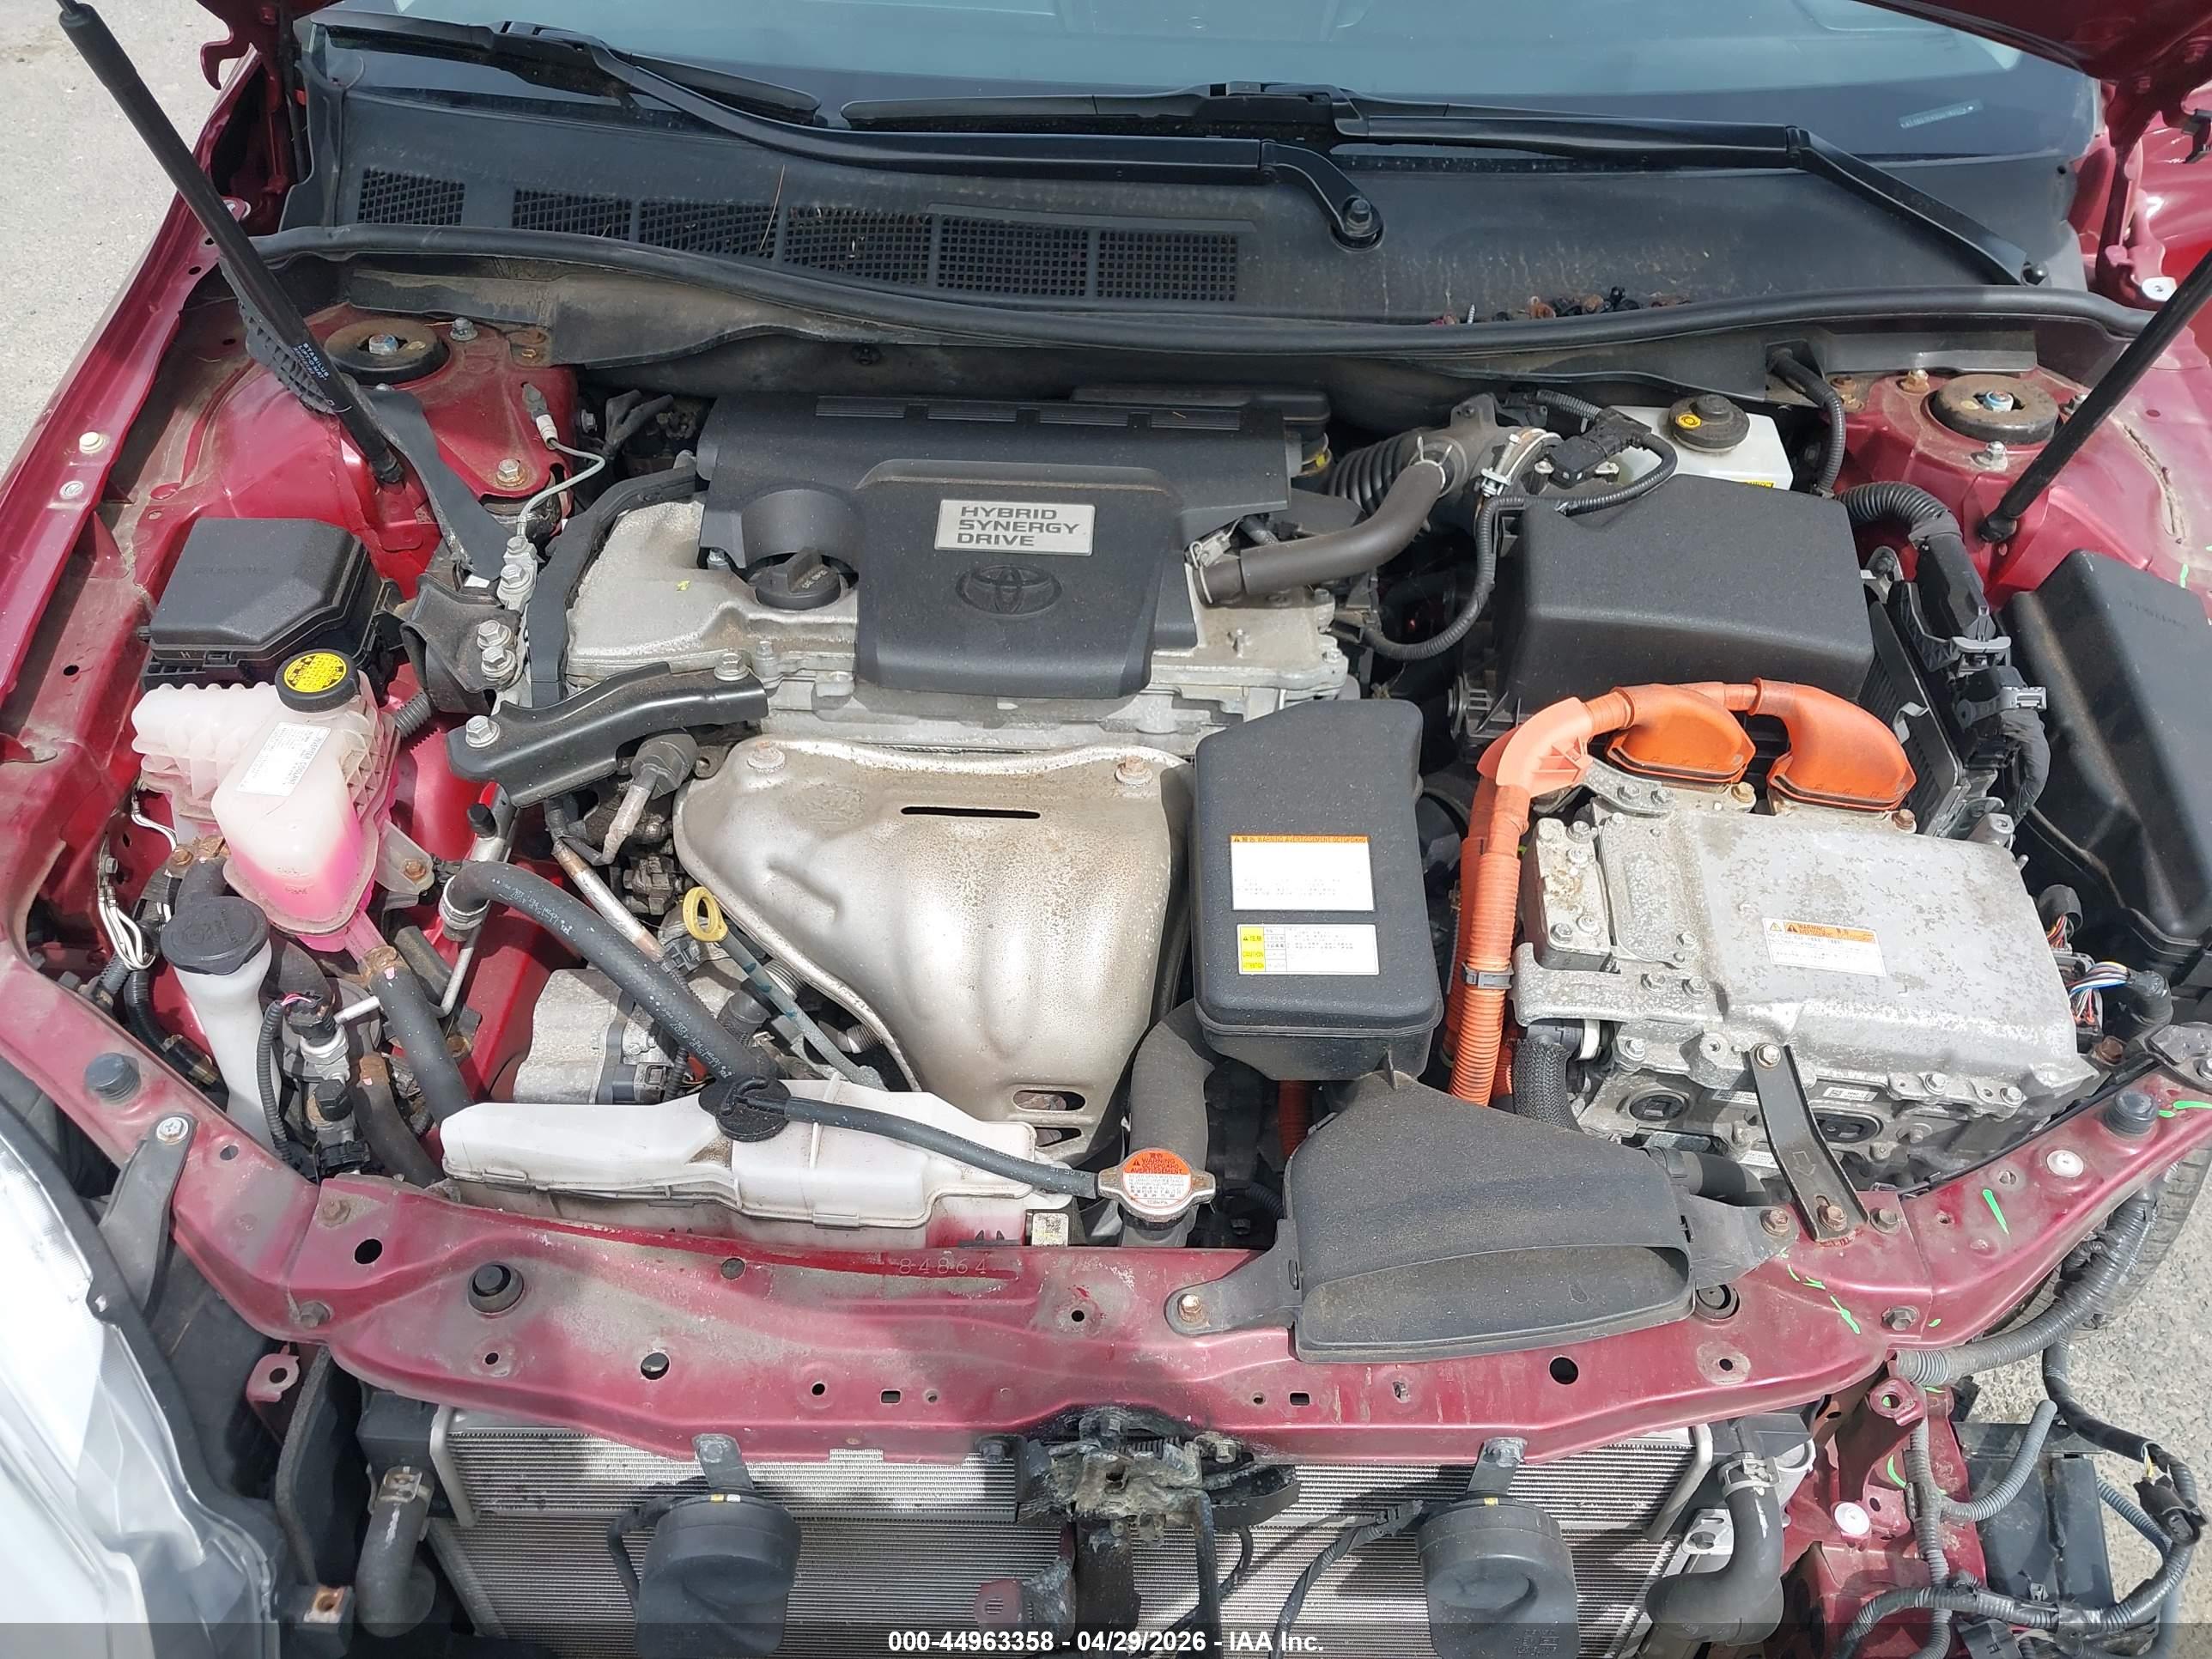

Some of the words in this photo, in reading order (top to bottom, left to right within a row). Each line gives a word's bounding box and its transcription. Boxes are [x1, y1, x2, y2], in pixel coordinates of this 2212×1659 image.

[302, 343, 329, 377] STABILUS
[961, 507, 1058, 520] HYBRID
[958, 520, 1080, 534] SYNERGY
[957, 532, 1036, 547] DRIVE
